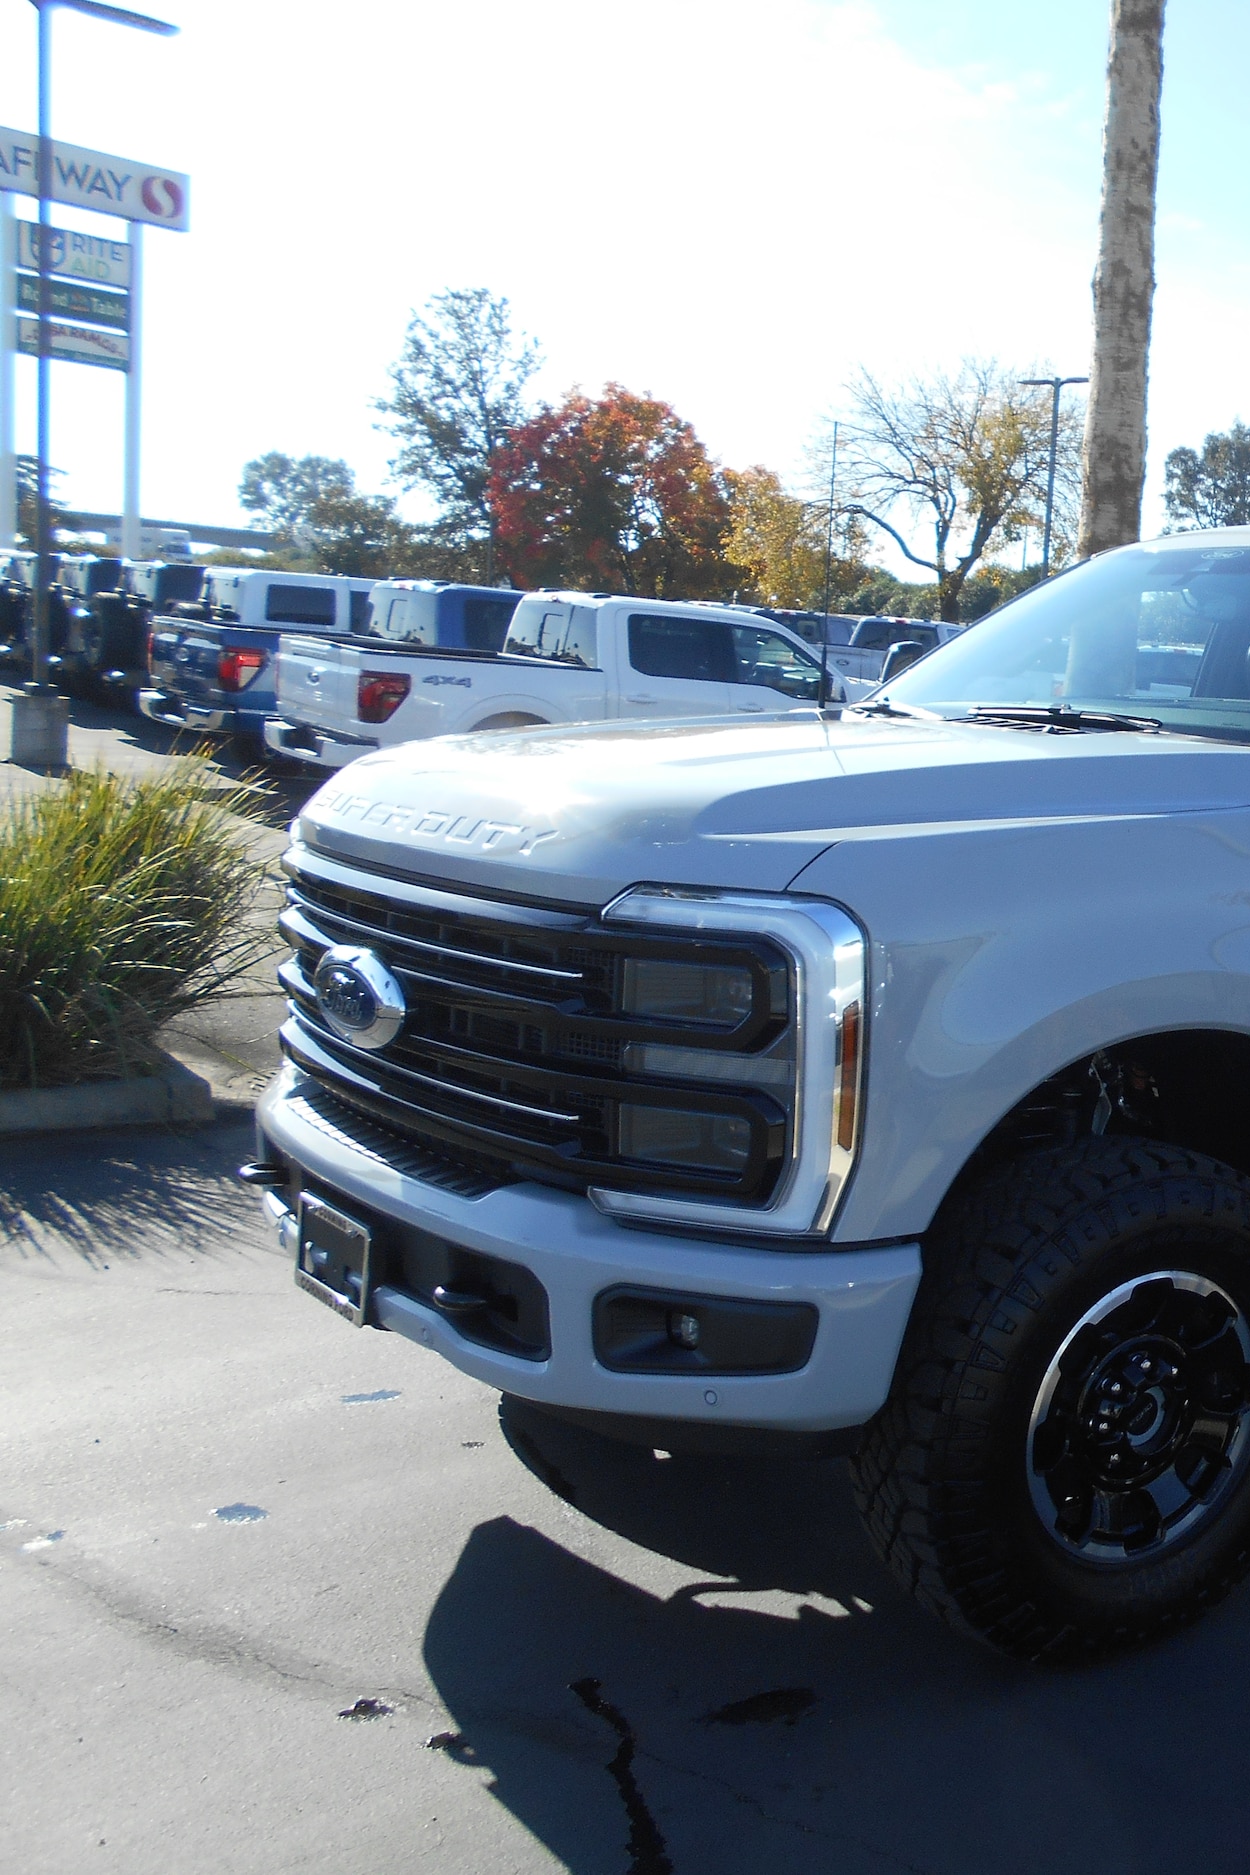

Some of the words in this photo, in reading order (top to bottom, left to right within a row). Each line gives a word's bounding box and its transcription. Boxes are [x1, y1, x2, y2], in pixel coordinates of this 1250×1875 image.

[72, 232, 124, 262] RITE
[71, 256, 110, 279] AID
[315, 790, 416, 832] SUPER
[411, 810, 559, 855] DUTY
